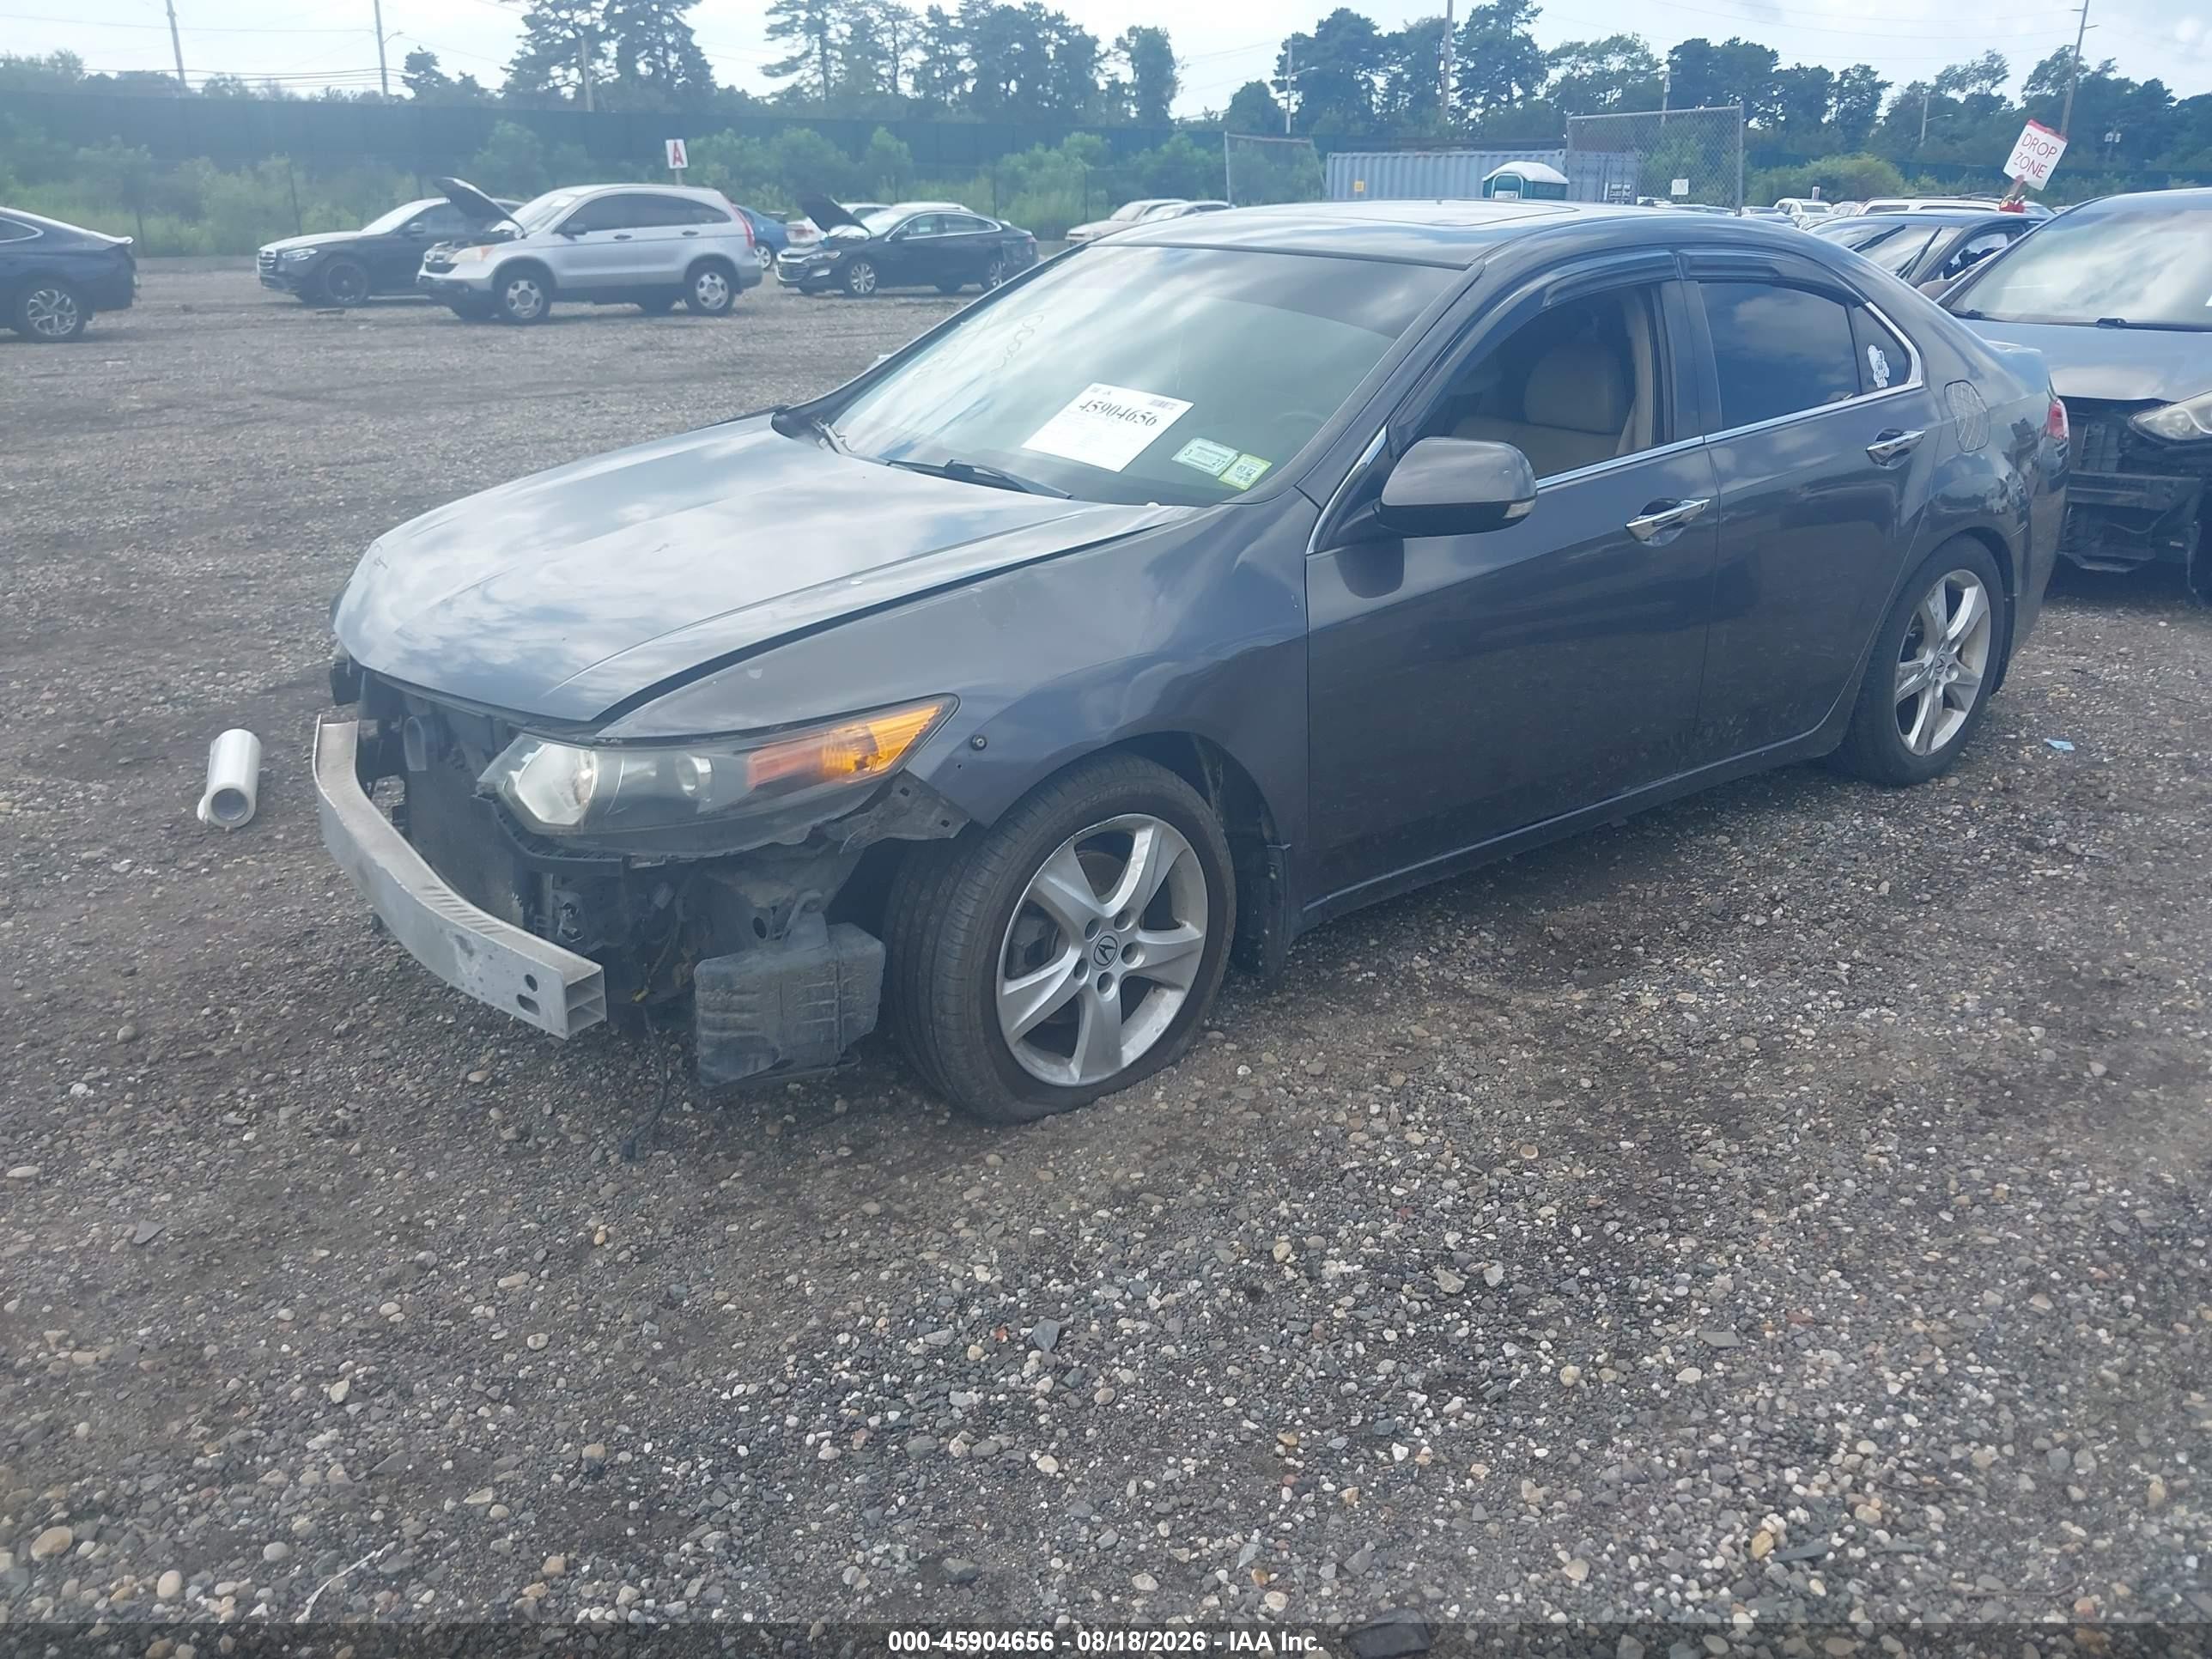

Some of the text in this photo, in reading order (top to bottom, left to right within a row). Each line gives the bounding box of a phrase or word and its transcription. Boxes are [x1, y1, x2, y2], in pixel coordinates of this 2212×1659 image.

[672, 142, 684, 166] A
[2021, 132, 2057, 159] DROP
[2014, 151, 2048, 179] ZONE
[1079, 399, 1158, 426] 45904656
